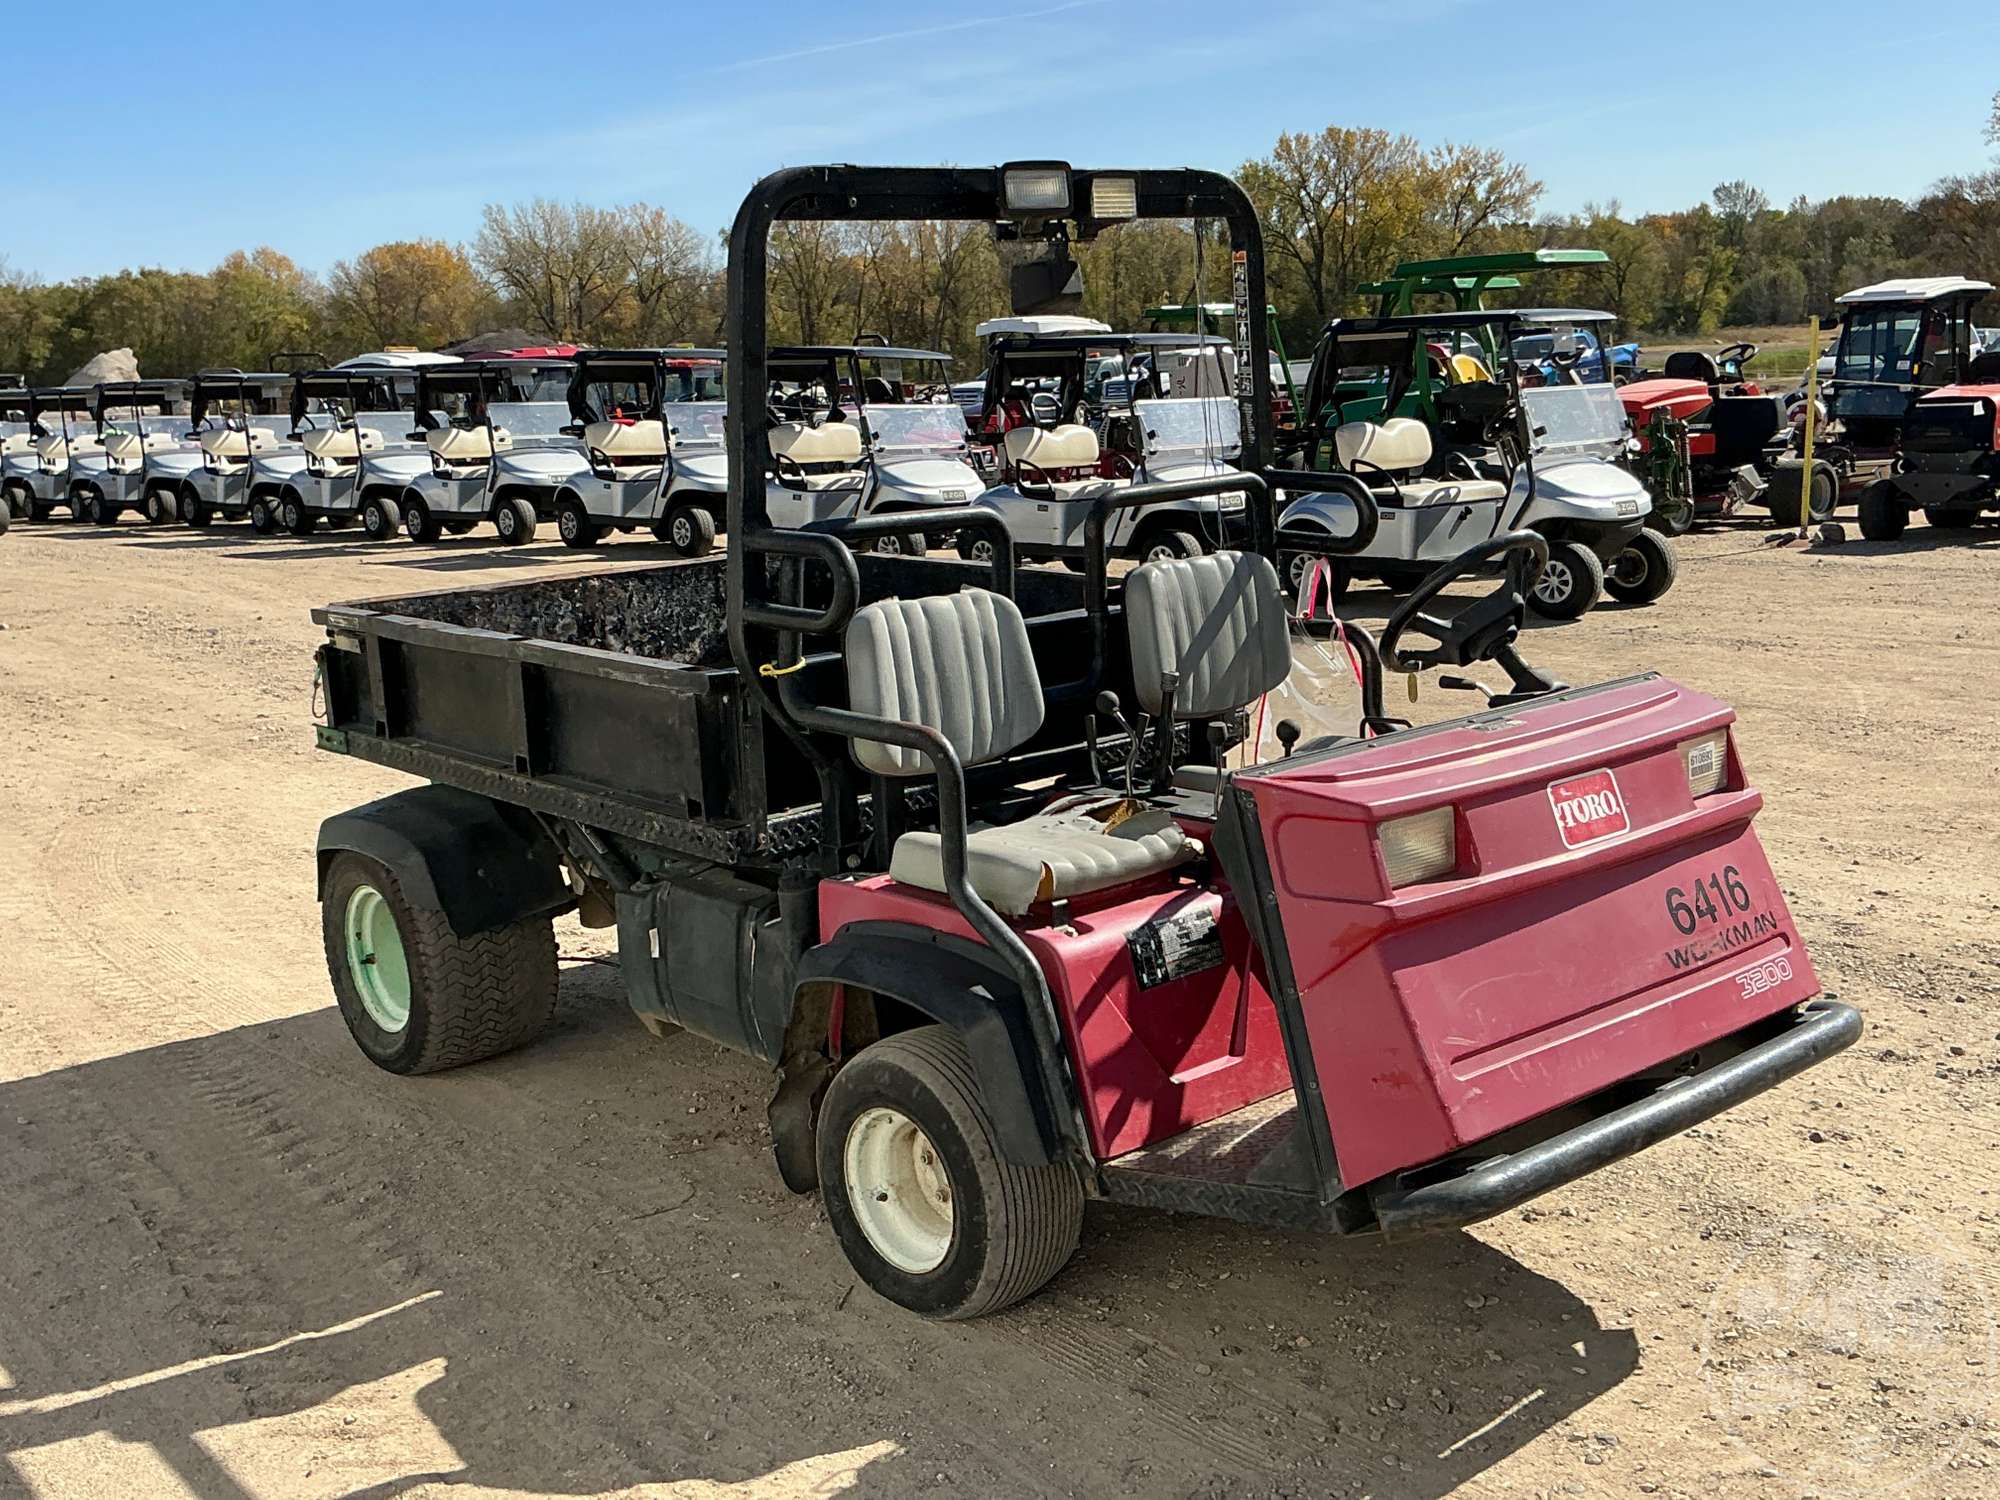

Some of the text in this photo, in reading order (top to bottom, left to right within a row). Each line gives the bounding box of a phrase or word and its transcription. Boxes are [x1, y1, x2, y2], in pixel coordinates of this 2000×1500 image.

[1557, 790, 1617, 827] TORO
[1665, 865, 1750, 935] 6416
[1665, 911, 1778, 969] WOKMAN
[1735, 957, 1793, 1000] 3200
